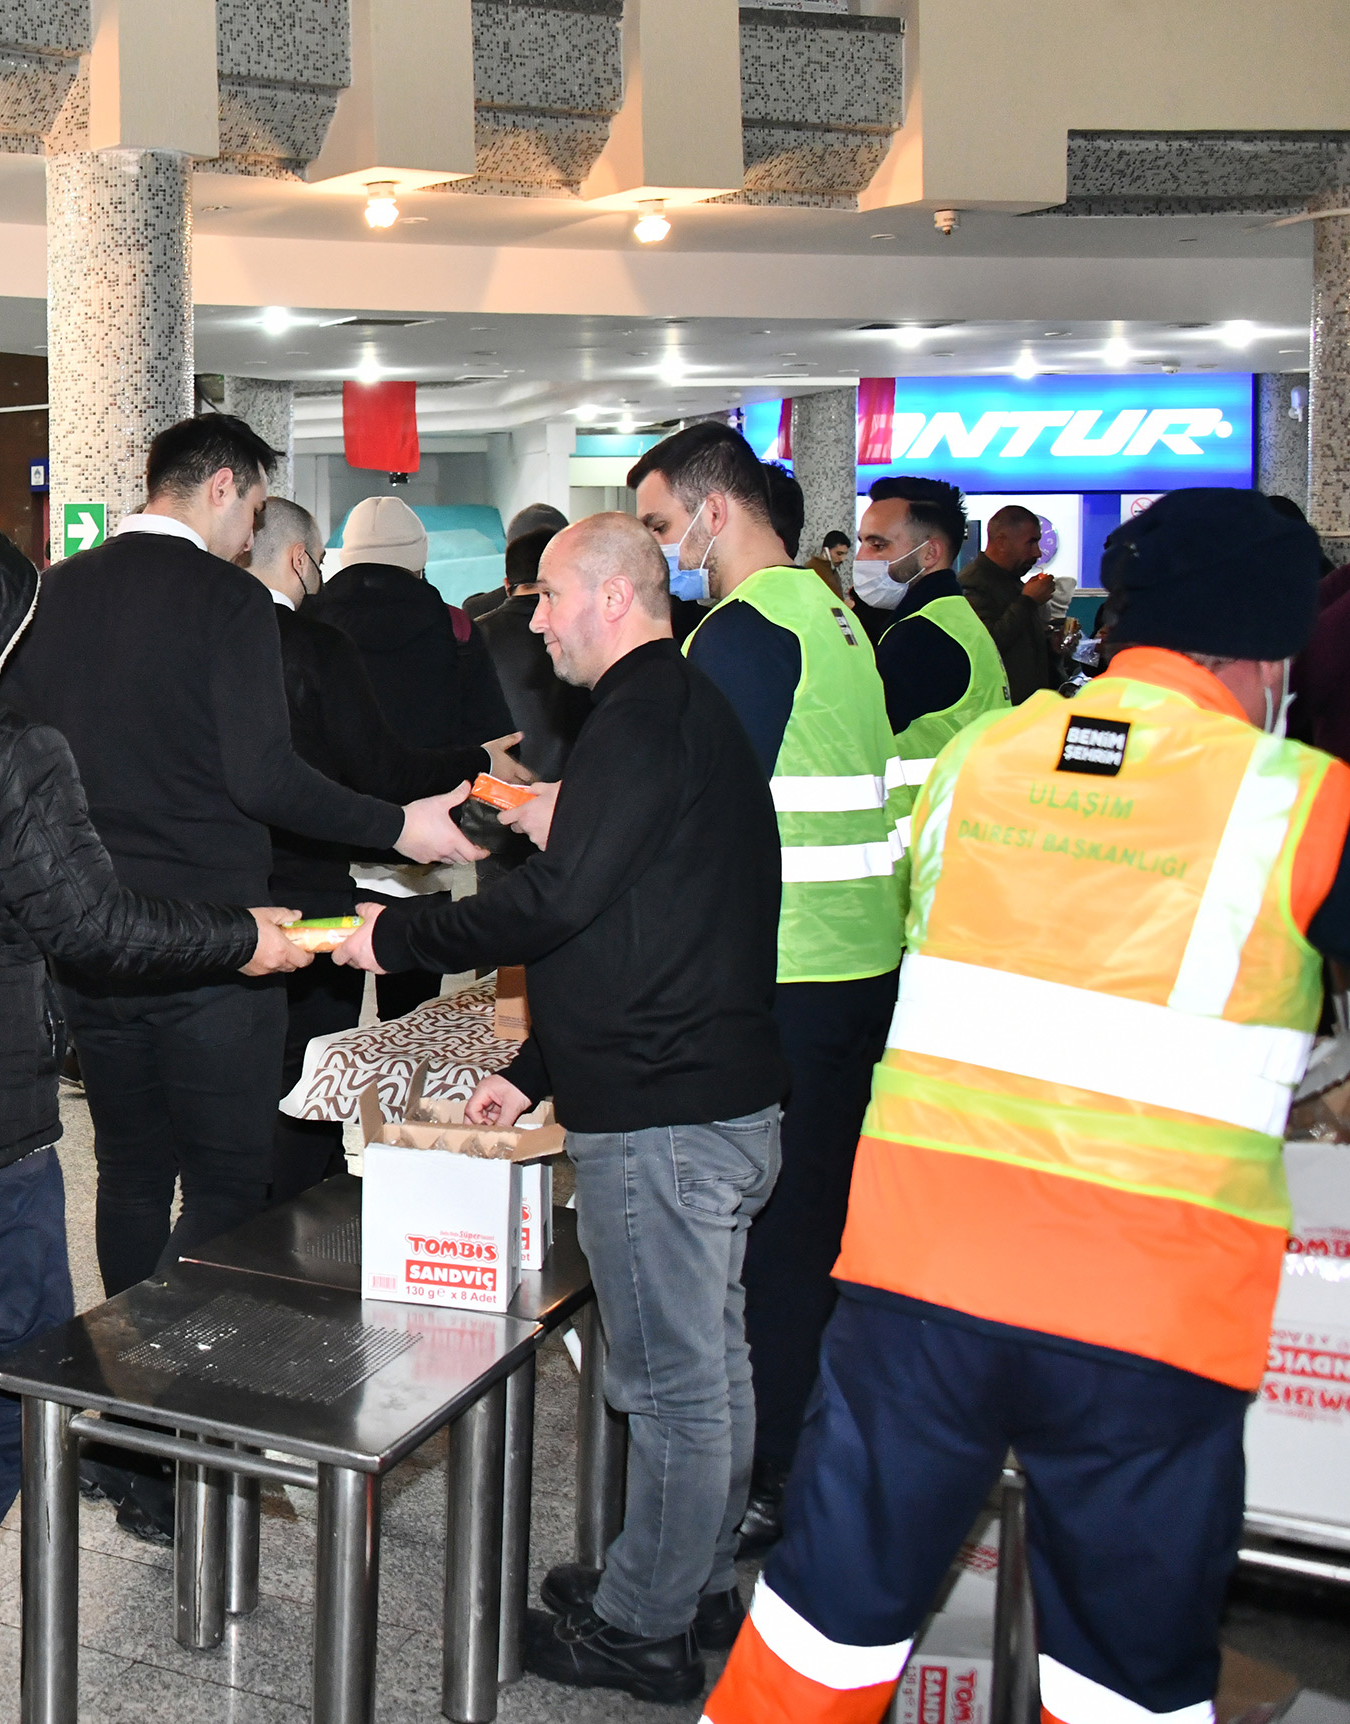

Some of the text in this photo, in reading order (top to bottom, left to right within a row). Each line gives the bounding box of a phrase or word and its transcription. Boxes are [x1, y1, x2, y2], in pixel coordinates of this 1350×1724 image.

[1029, 782, 1134, 820] ULAŞIM
[406, 1285, 425, 1297] 130
[461, 1290, 468, 1301] 8
[470, 1291, 497, 1304] Adet
[409, 1264, 494, 1291] SANDVİÇ
[923, 1669, 942, 1724] SAND
[953, 1671, 976, 1724] TOM
